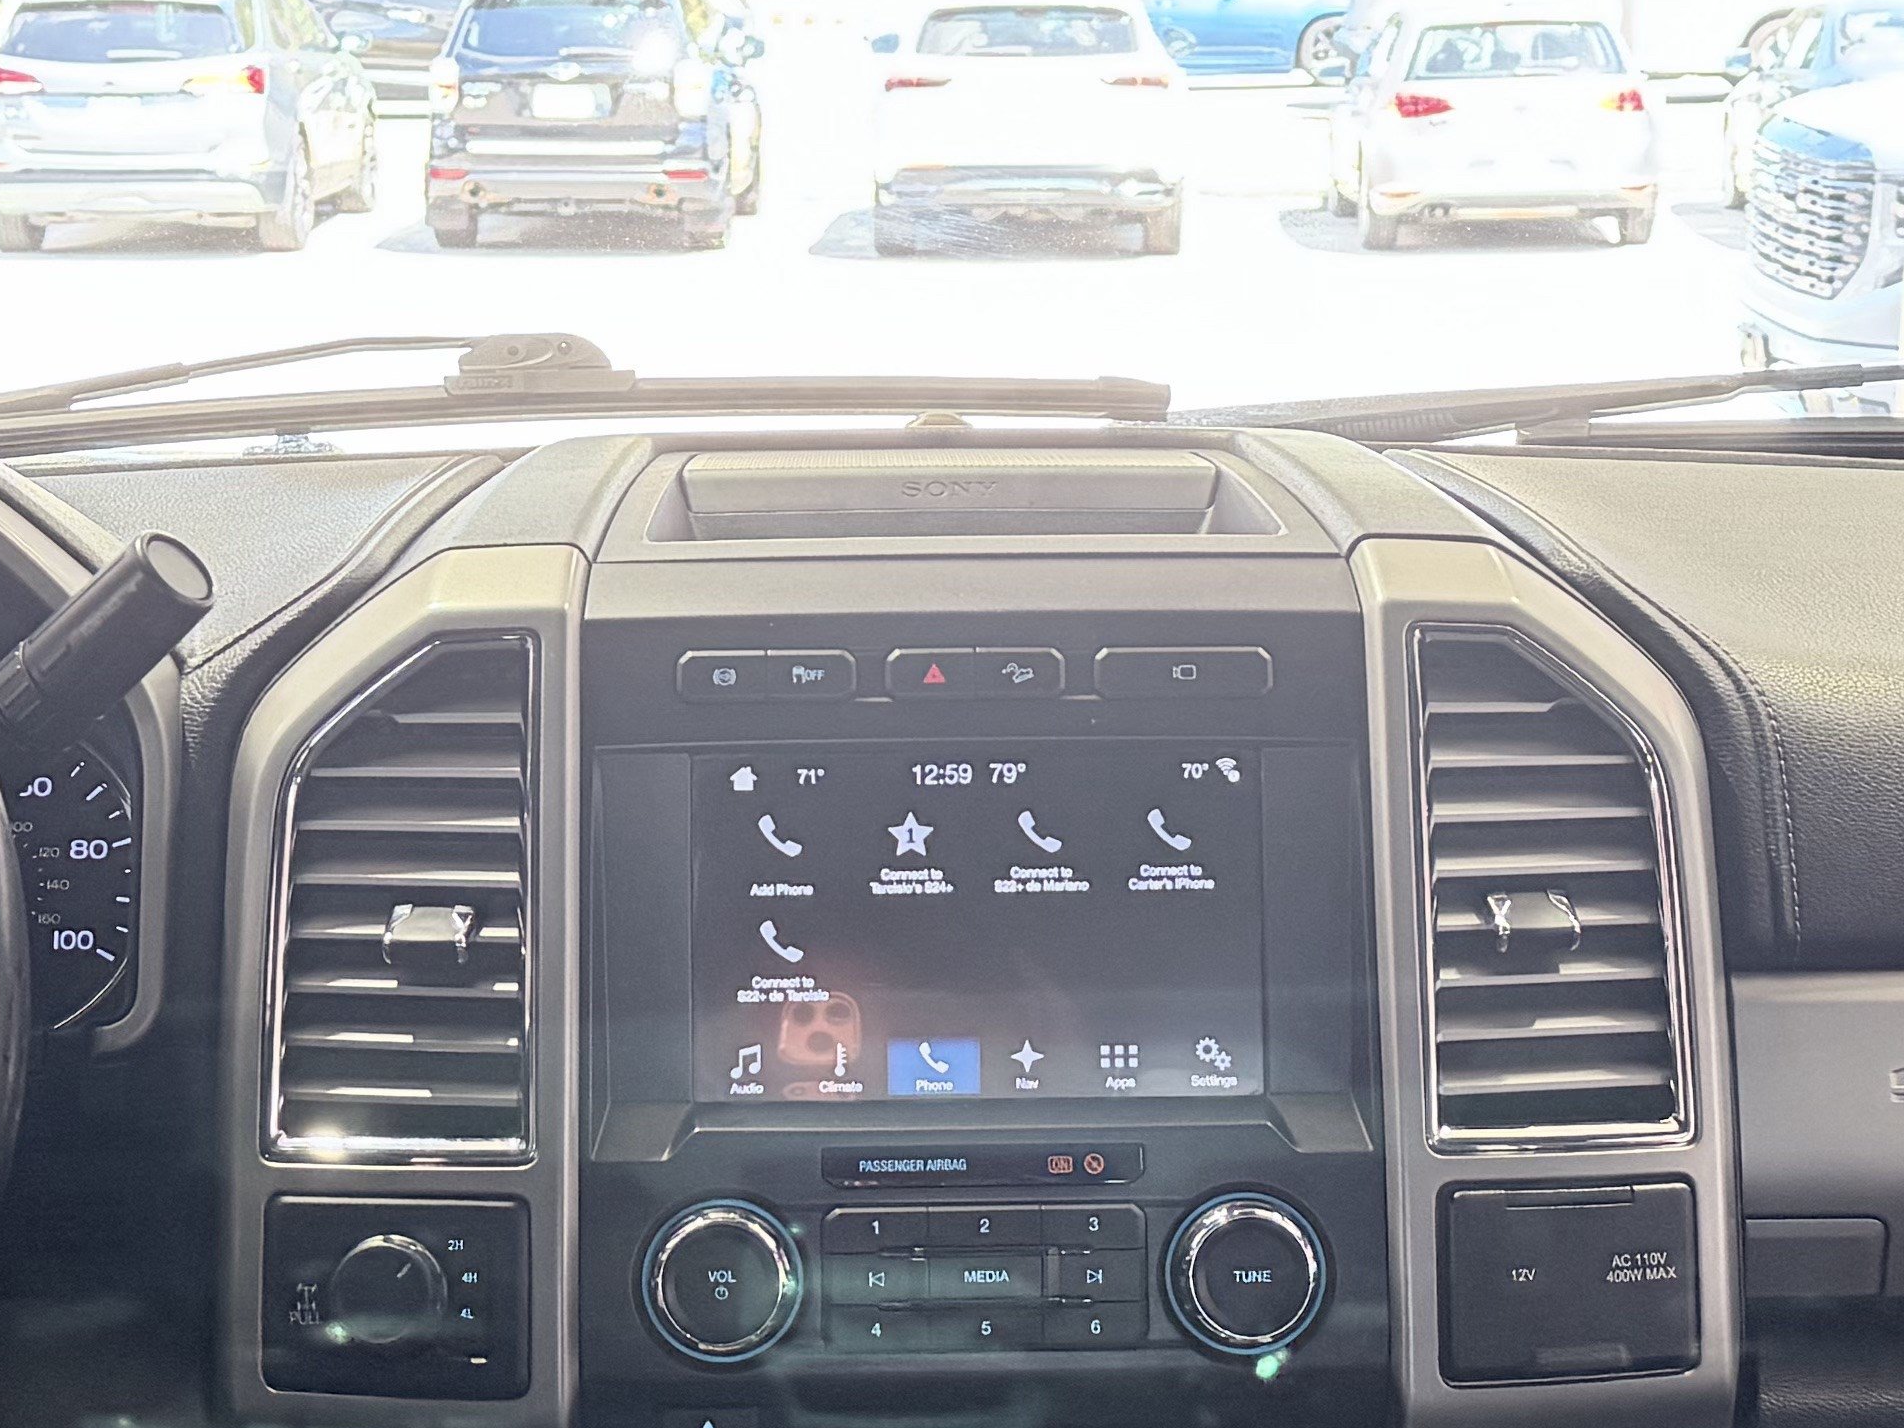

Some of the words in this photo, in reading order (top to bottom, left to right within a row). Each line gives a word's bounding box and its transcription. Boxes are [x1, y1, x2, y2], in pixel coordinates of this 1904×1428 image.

[912, 763, 973, 785] 12:59
[69, 839, 108, 860] 80
[880, 868, 928, 881] Connect
[931, 868, 944, 881] to
[1010, 866, 1058, 879] Connect
[1060, 866, 1073, 879] to
[1139, 864, 1187, 878] Connect
[1190, 864, 1203, 877] to
[750, 883, 774, 897] Add
[776, 883, 814, 897] Phone
[53, 930, 94, 951] 100
[752, 975, 800, 989] Connect
[802, 976, 815, 989] to
[819, 1080, 863, 1093] Climate
[915, 1079, 954, 1092] Phone
[1015, 1077, 1040, 1090] Nav
[1105, 1076, 1136, 1090] Apps
[1190, 1074, 1238, 1088] Settings
[729, 1082, 764, 1095] Audio
[859, 1158, 924, 1172] PASSENGER
[926, 1158, 967, 1171] AIRBAG
[872, 1220, 880, 1235] 1
[979, 1218, 990, 1233] 2
[1089, 1217, 1099, 1231] 3
[447, 1239, 464, 1251] 2H
[1612, 1254, 1631, 1267] AC
[1635, 1252, 1667, 1266] 110V
[461, 1273, 478, 1284] 4H
[707, 1269, 736, 1284] VOL
[963, 1269, 1010, 1284] MEDIA
[1232, 1269, 1272, 1284] TUNE
[1511, 1268, 1536, 1282] 12V
[1606, 1269, 1642, 1283] 400W
[1646, 1266, 1677, 1281] MAX
[870, 1322, 882, 1337] 4
[980, 1321, 992, 1336] 5
[1090, 1320, 1101, 1335] 6
